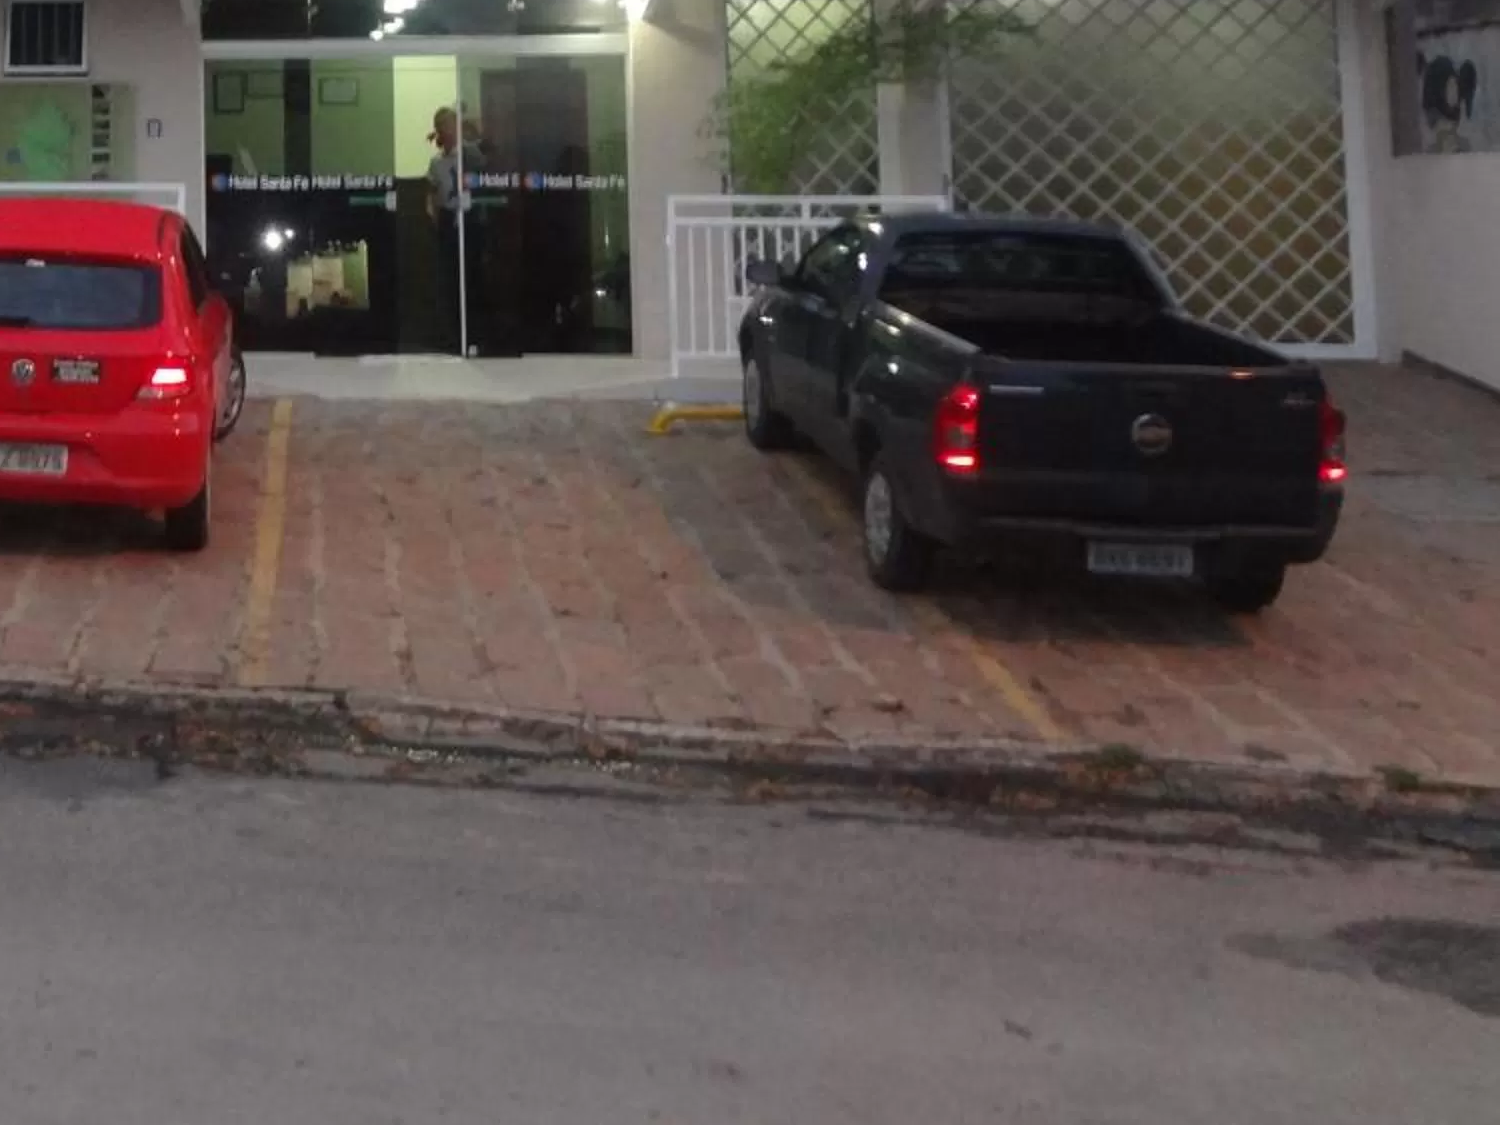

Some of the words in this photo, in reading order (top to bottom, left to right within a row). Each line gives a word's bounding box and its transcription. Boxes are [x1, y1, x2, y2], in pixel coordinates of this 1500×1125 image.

[228, 174, 258, 190] Hotel
[259, 175, 292, 191] Santa
[312, 174, 342, 190] Hotel
[344, 175, 376, 190] Santa
[479, 173, 509, 189] Hotel
[543, 174, 573, 189] Hotel
[575, 175, 608, 191] Santa
